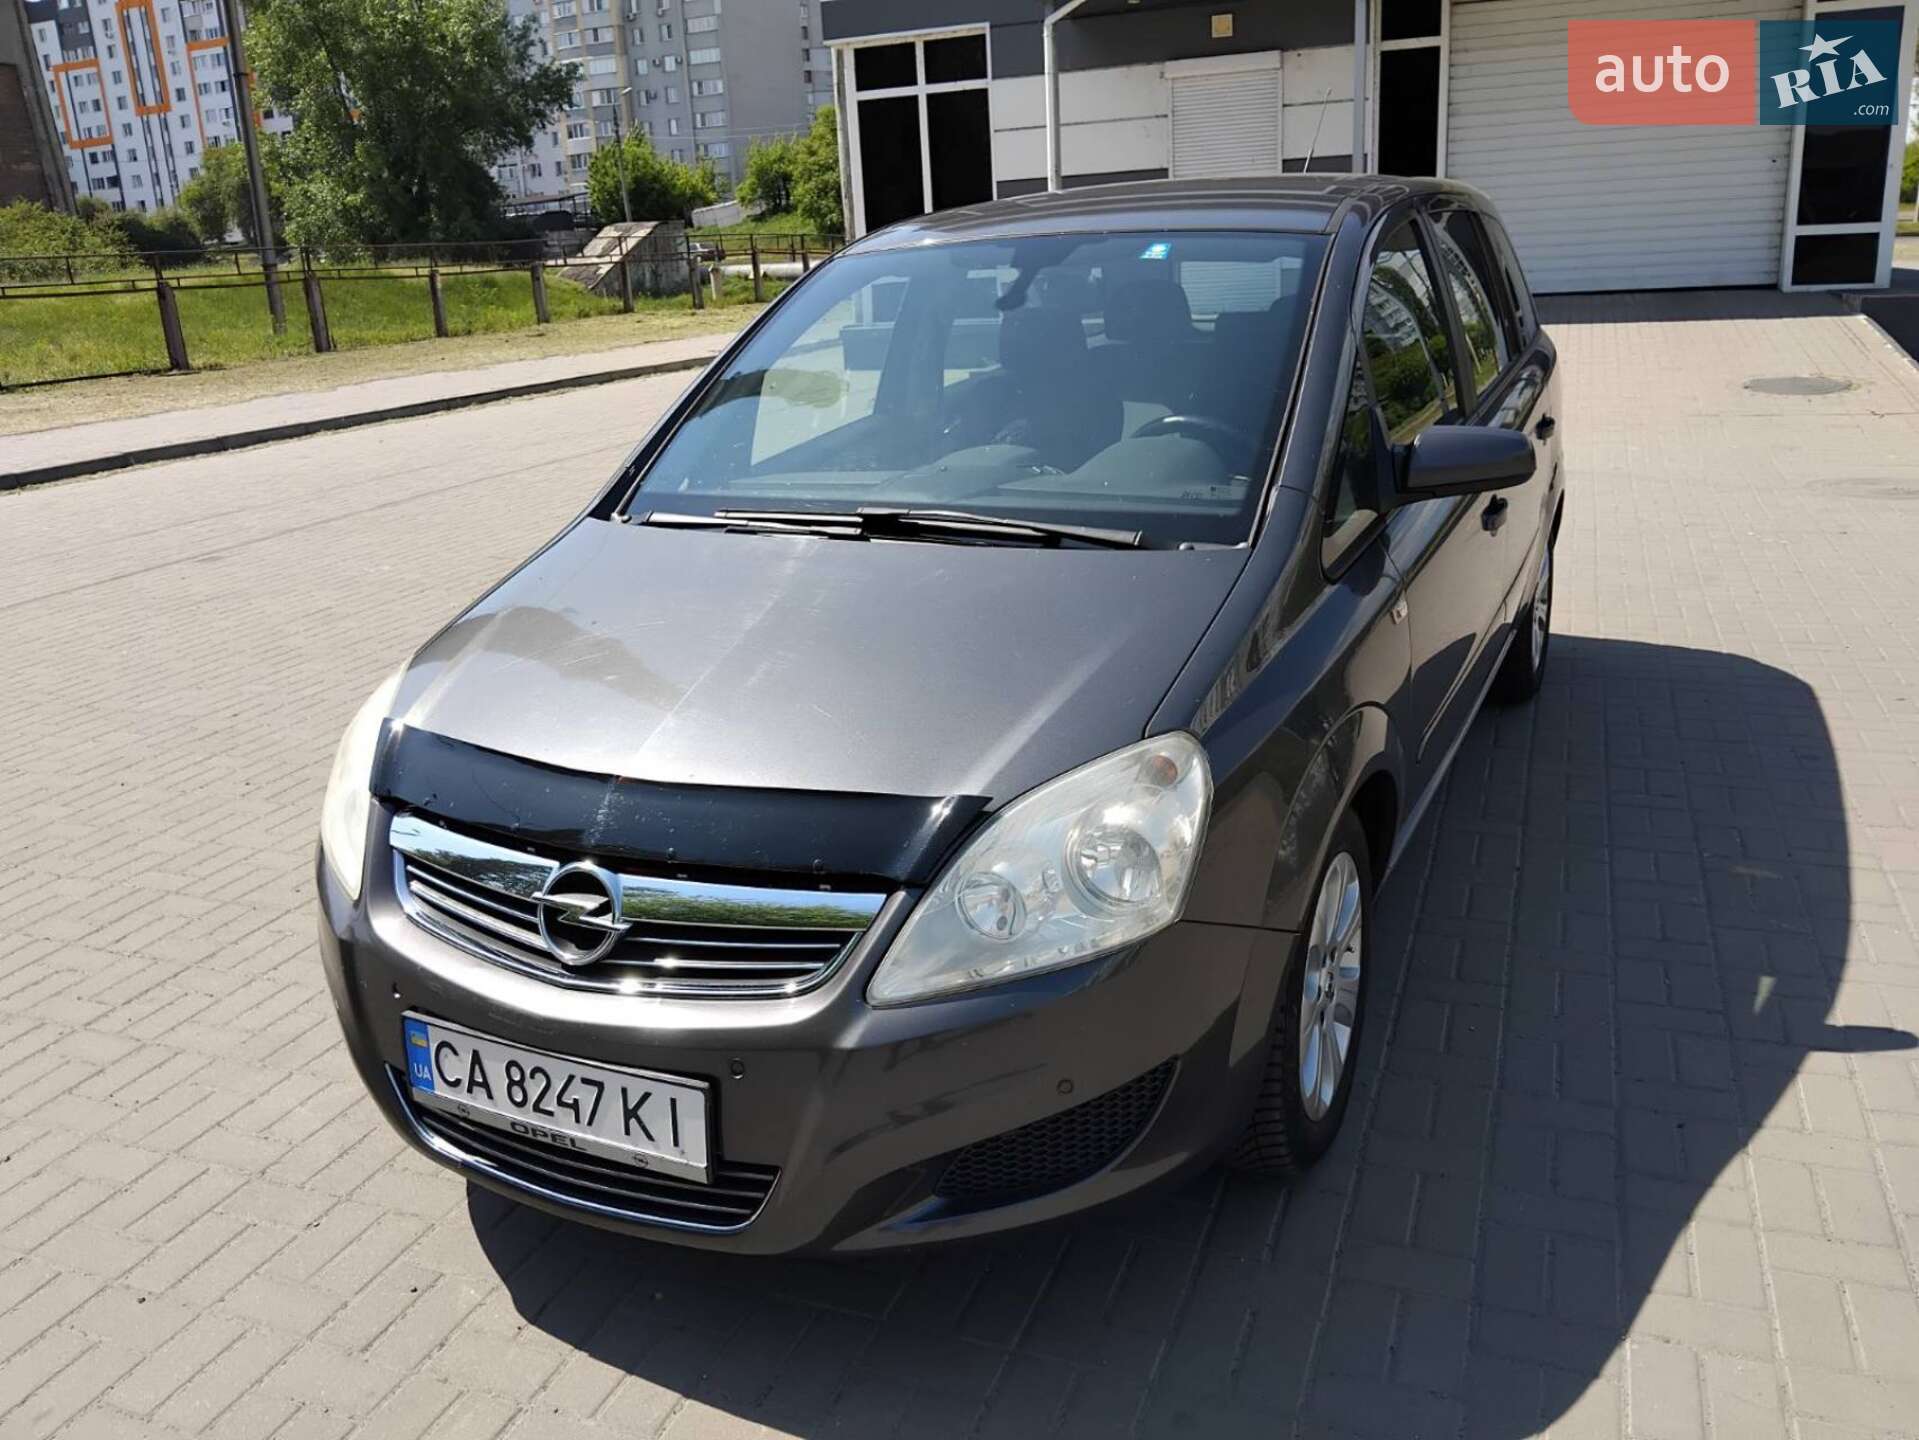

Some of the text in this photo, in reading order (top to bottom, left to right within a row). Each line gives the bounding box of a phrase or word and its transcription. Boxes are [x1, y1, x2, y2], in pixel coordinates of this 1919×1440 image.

[414, 1063, 432, 1081] UA
[434, 1039, 679, 1148] CA 8247 KI
[510, 1121, 587, 1151] OPEL
